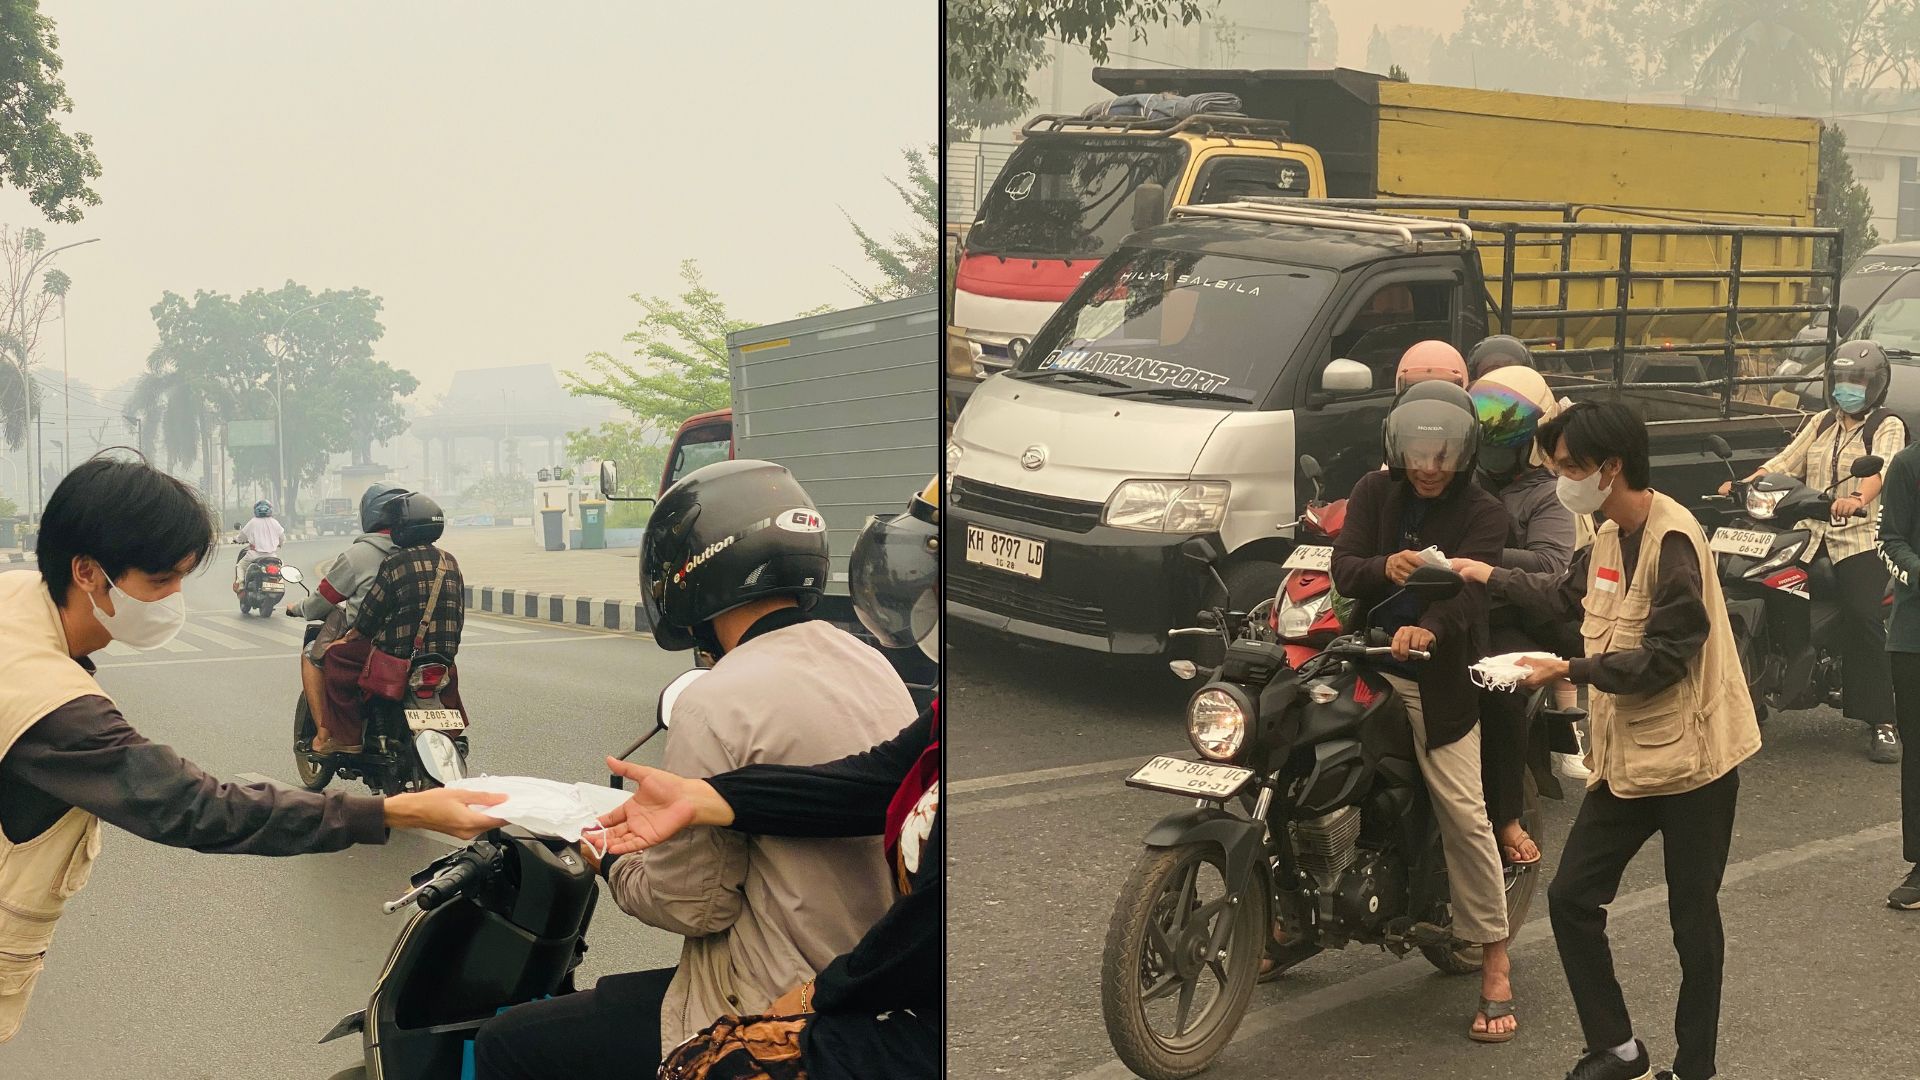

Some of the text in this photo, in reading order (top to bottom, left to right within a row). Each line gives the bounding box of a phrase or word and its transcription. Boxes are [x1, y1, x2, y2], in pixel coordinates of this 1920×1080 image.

[1120, 271, 1169, 281] HILYA
[791, 512, 820, 528] GM
[1716, 529, 1728, 540] KH
[968, 529, 1043, 566] KH 8797 LD
[1293, 547, 1311, 556] KH
[673, 535, 735, 584] evolution
[407, 711, 420, 720] KH
[423, 710, 447, 720] 2805
[1148, 759, 1174, 770] KH
[1176, 762, 1219, 777] 3804
